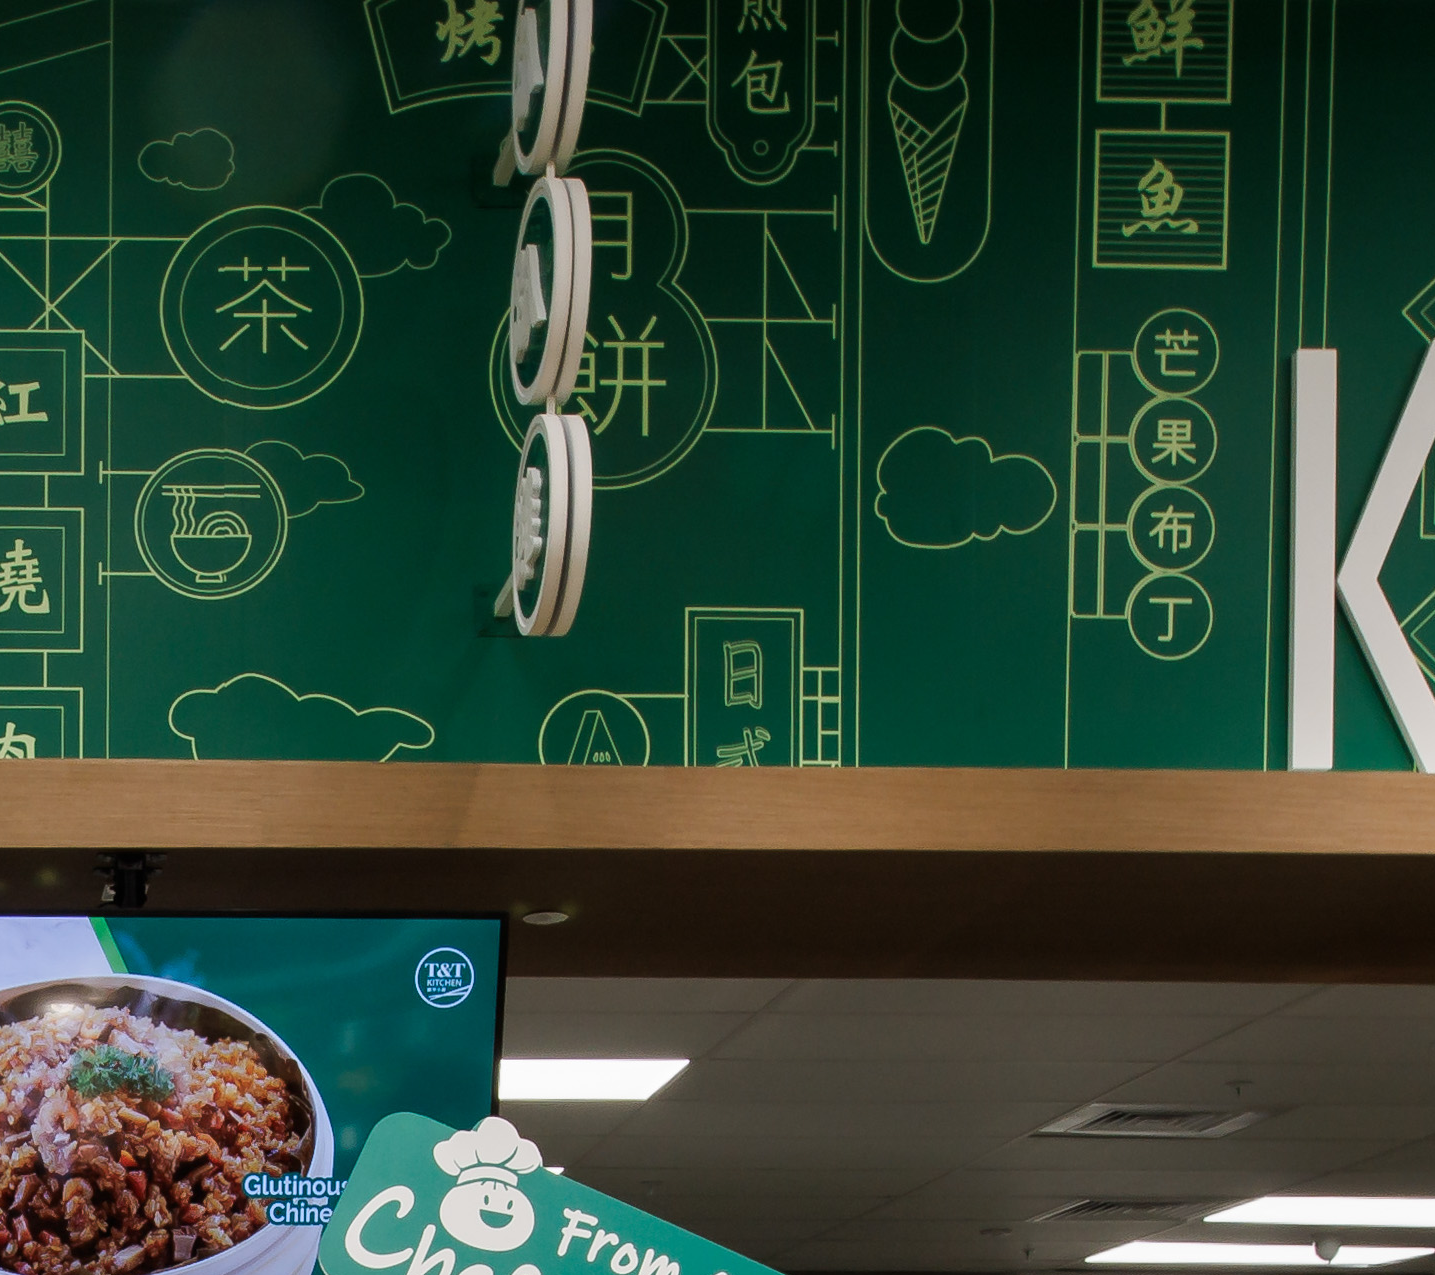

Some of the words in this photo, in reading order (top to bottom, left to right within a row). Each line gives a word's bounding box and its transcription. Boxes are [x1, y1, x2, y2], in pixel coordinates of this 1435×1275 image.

[214, 256, 314, 354] 茶
[1147, 328, 1202, 645] 芒果布丁
[424, 962, 467, 977] T&T
[426, 979, 462, 987] KITCHEN
